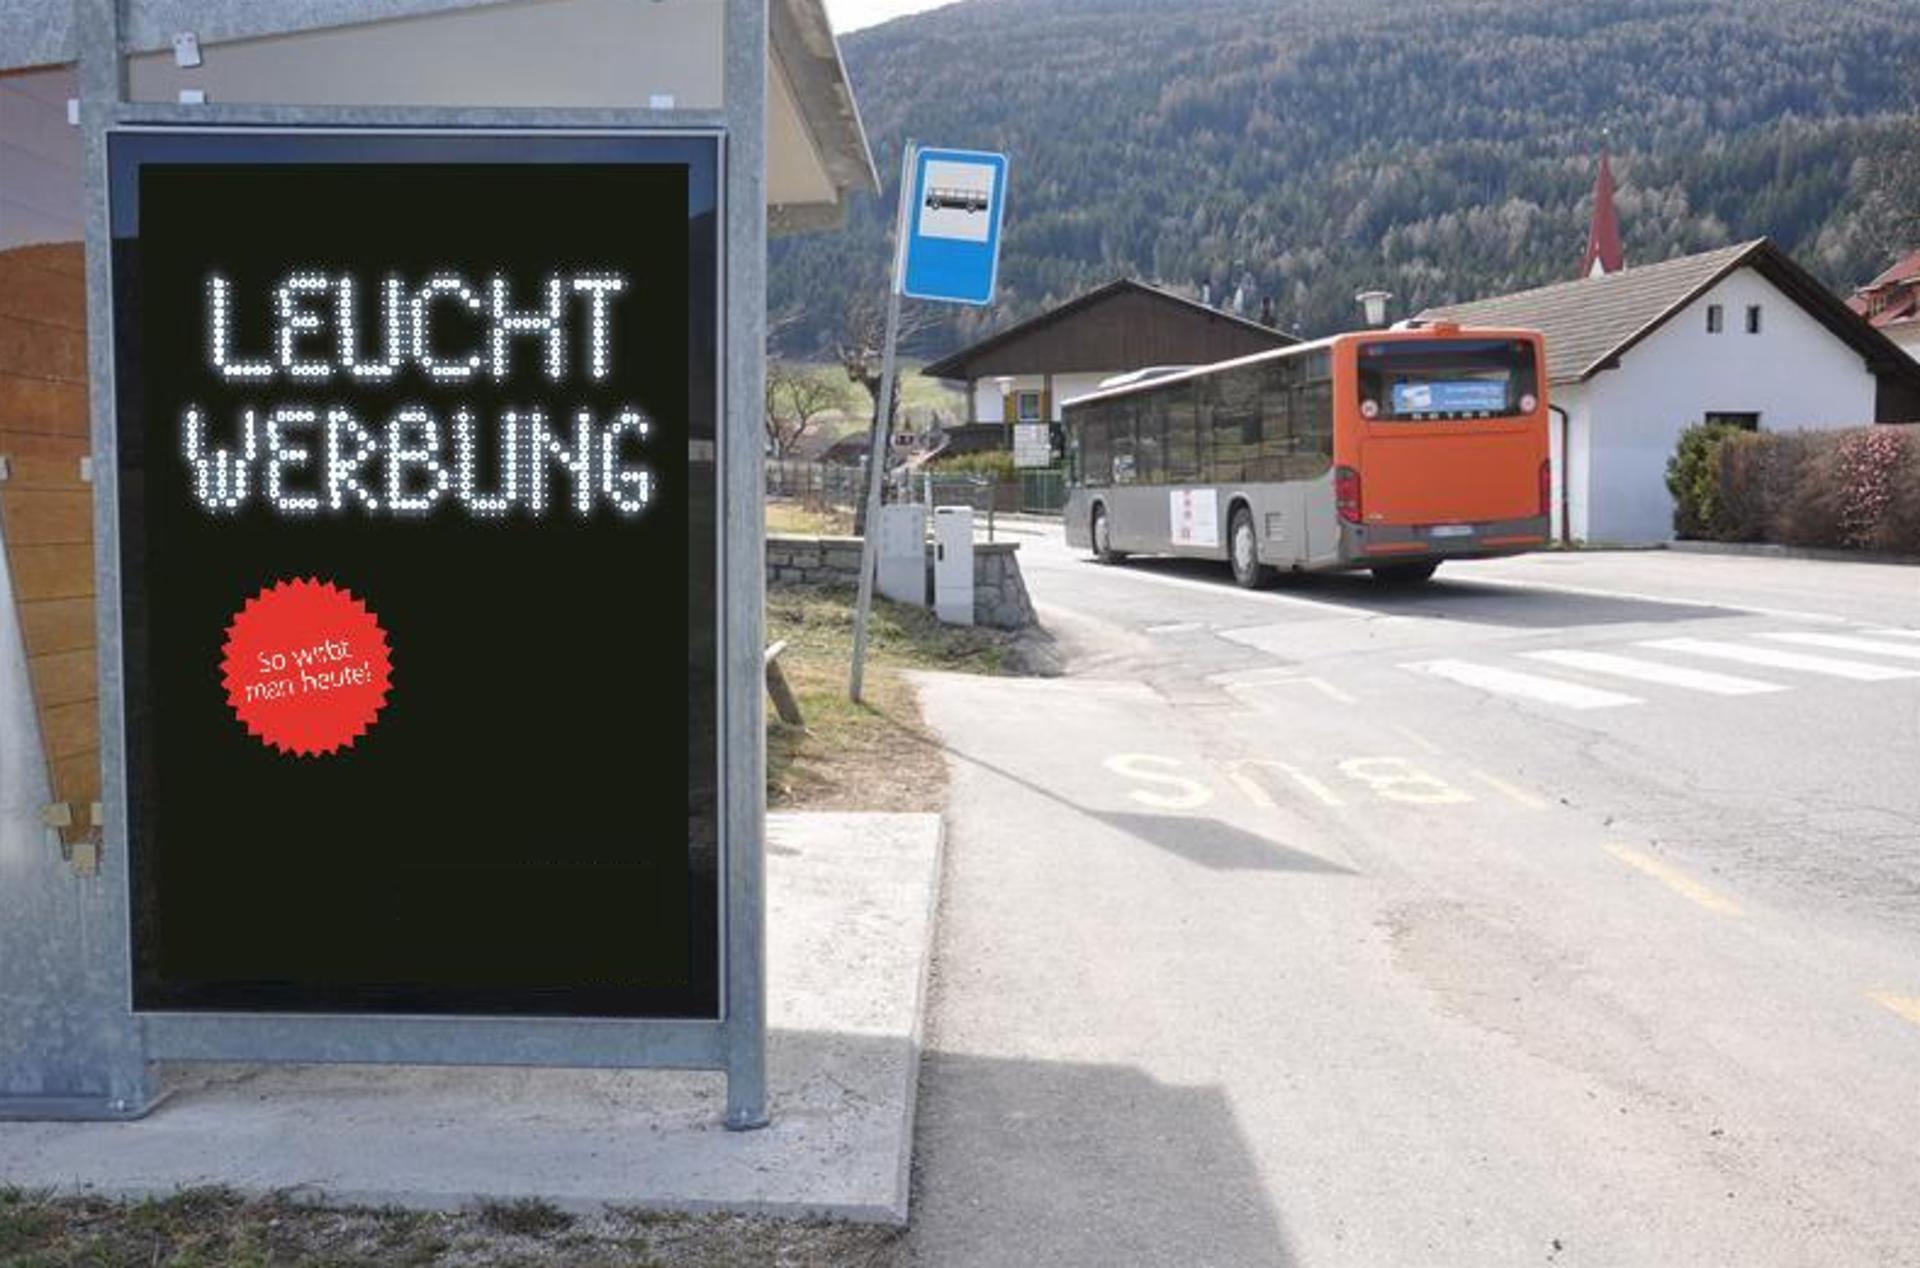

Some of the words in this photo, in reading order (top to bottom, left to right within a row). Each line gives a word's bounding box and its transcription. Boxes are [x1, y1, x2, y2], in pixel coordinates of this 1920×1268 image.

[206, 268, 628, 382] LEUCHT
[181, 402, 654, 516] WERBUNG
[245, 678, 295, 702] man
[301, 660, 372, 693] heute!
[257, 651, 286, 673] So
[1103, 753, 1476, 808] BUS
